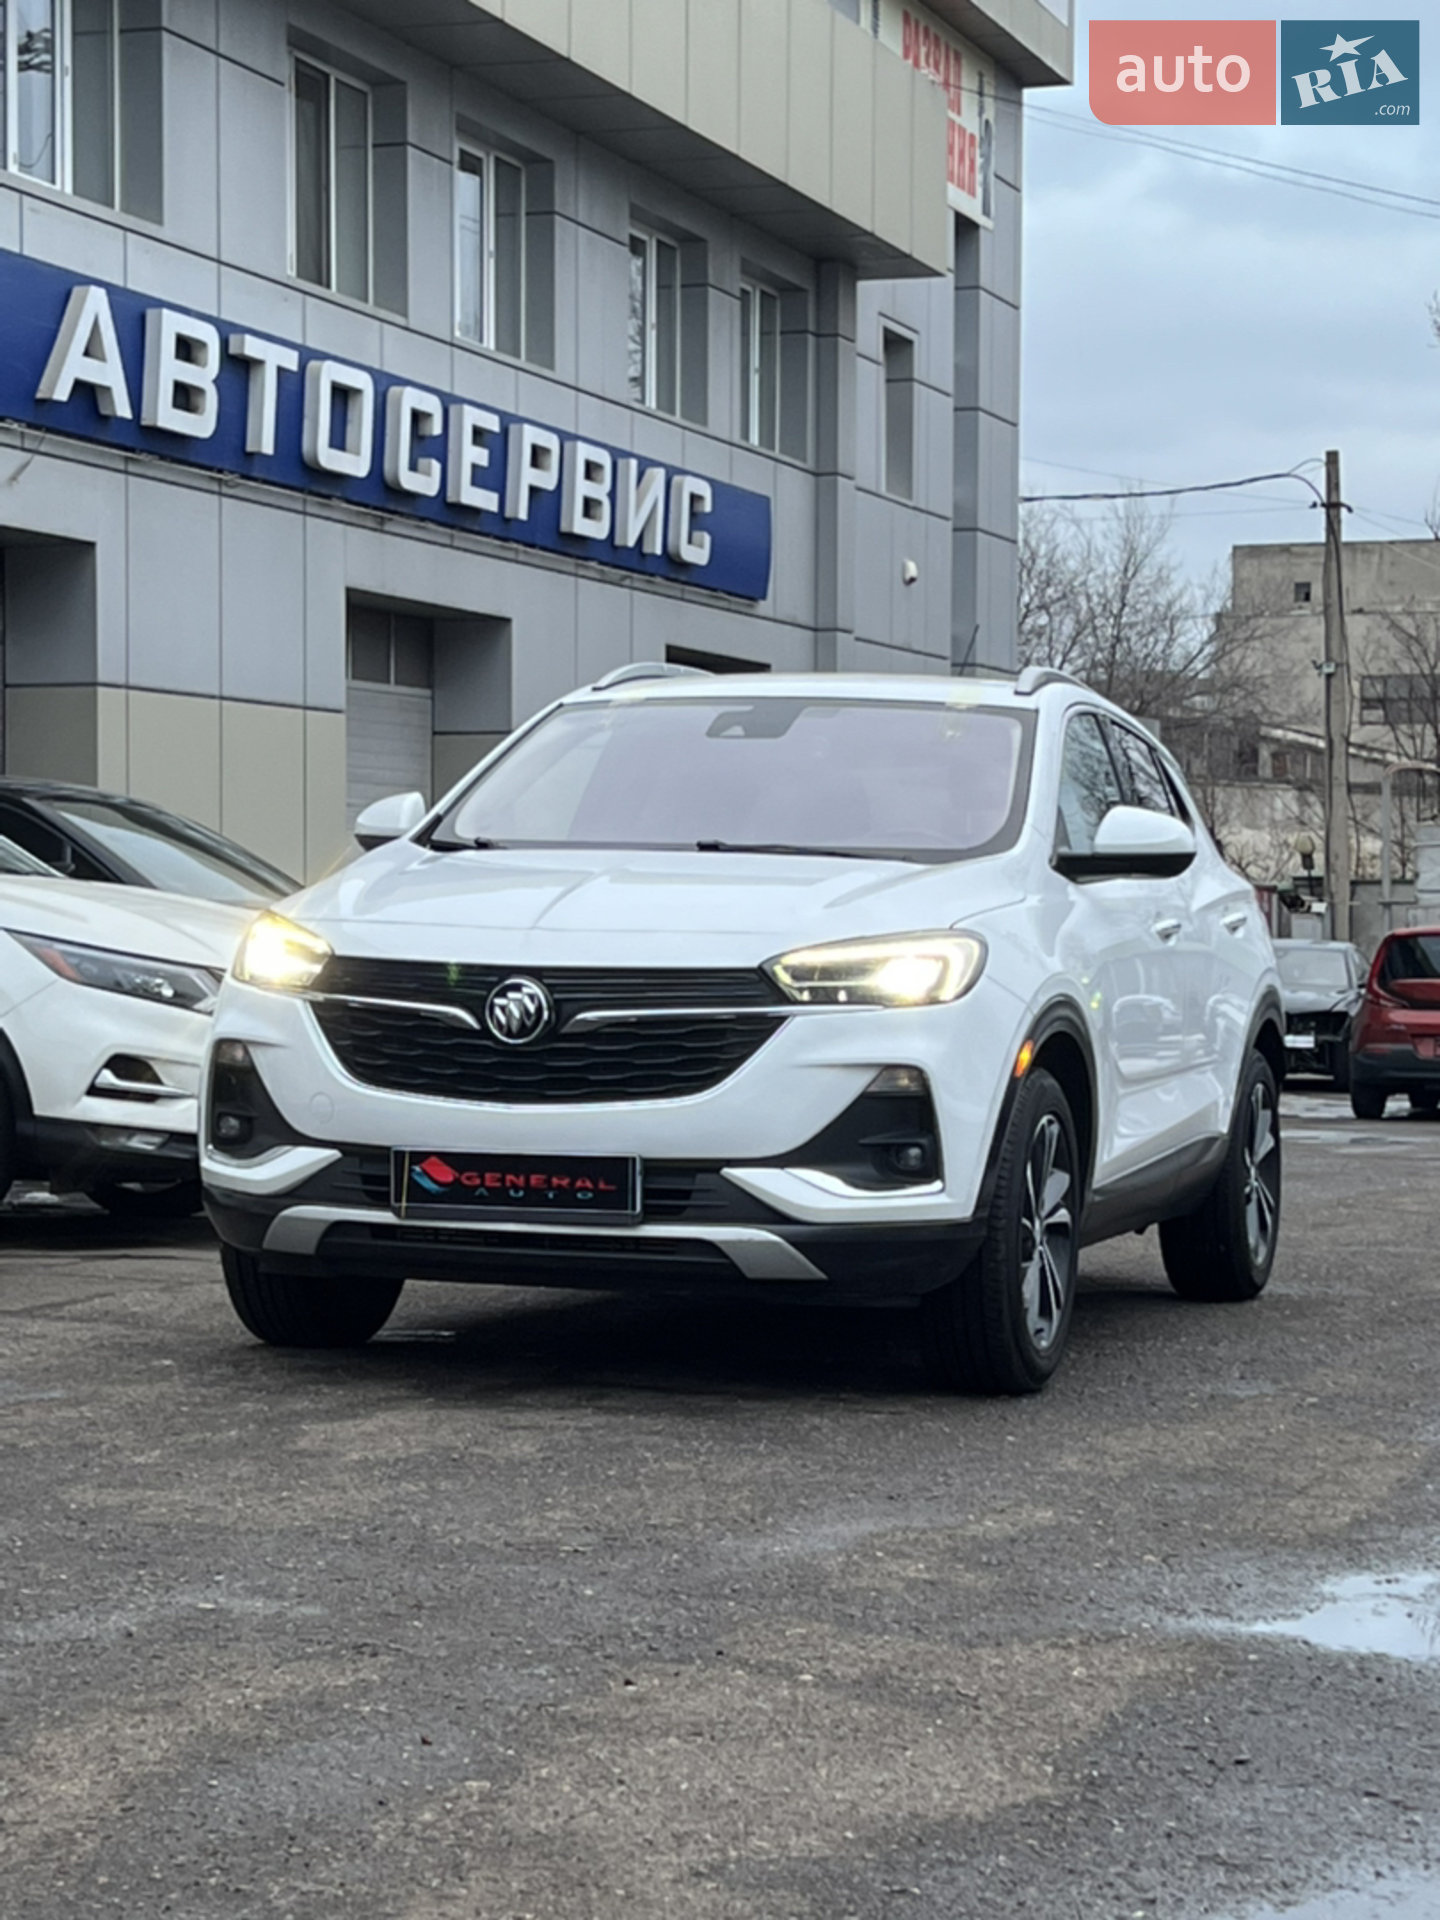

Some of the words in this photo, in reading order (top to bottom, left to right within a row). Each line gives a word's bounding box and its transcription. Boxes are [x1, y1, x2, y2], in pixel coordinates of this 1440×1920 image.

[35, 284, 713, 567] АВТОСЕРВИС
[460, 1171, 617, 1191] GENERAL
[474, 1186, 594, 1199] AUTO
